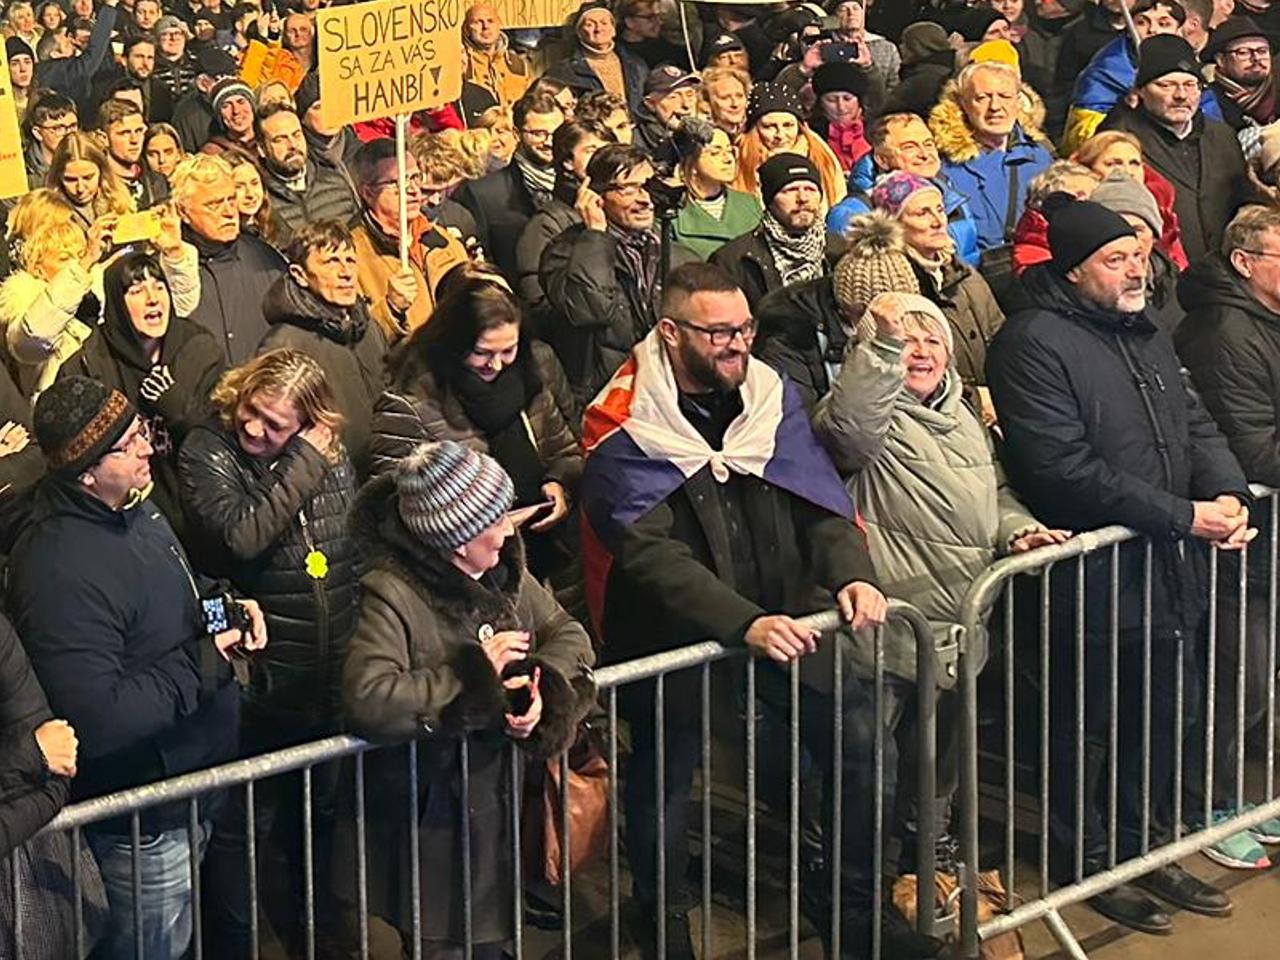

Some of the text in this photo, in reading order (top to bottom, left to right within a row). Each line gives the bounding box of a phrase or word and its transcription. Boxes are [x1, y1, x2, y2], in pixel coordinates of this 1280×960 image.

[339, 38, 436, 79] SA ZA VÁS
